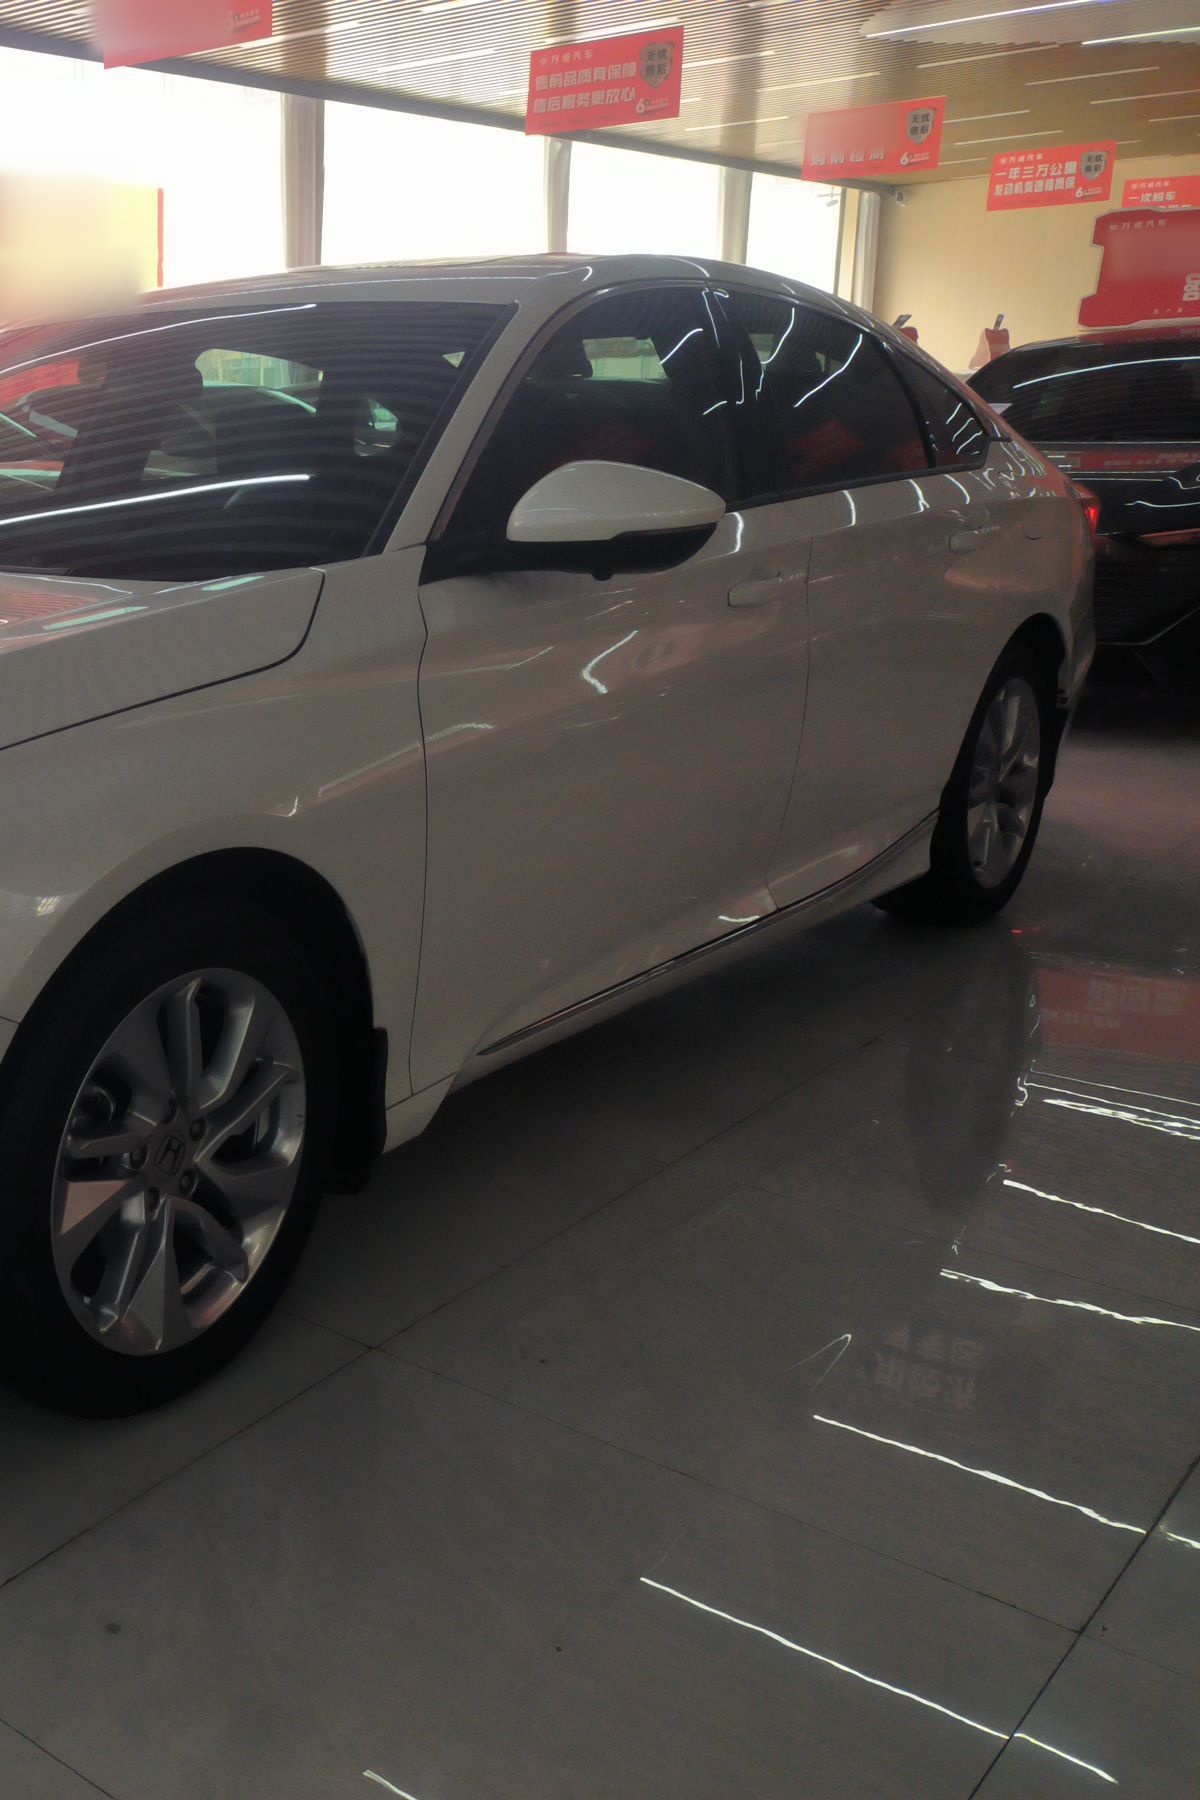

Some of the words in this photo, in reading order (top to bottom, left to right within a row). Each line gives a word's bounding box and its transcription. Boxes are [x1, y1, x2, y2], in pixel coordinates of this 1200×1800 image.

[535, 61, 637, 91] 售前品质有保障
[533, 86, 636, 114] 售后服务更放心
[994, 161, 1077, 179] 一年三万公里
